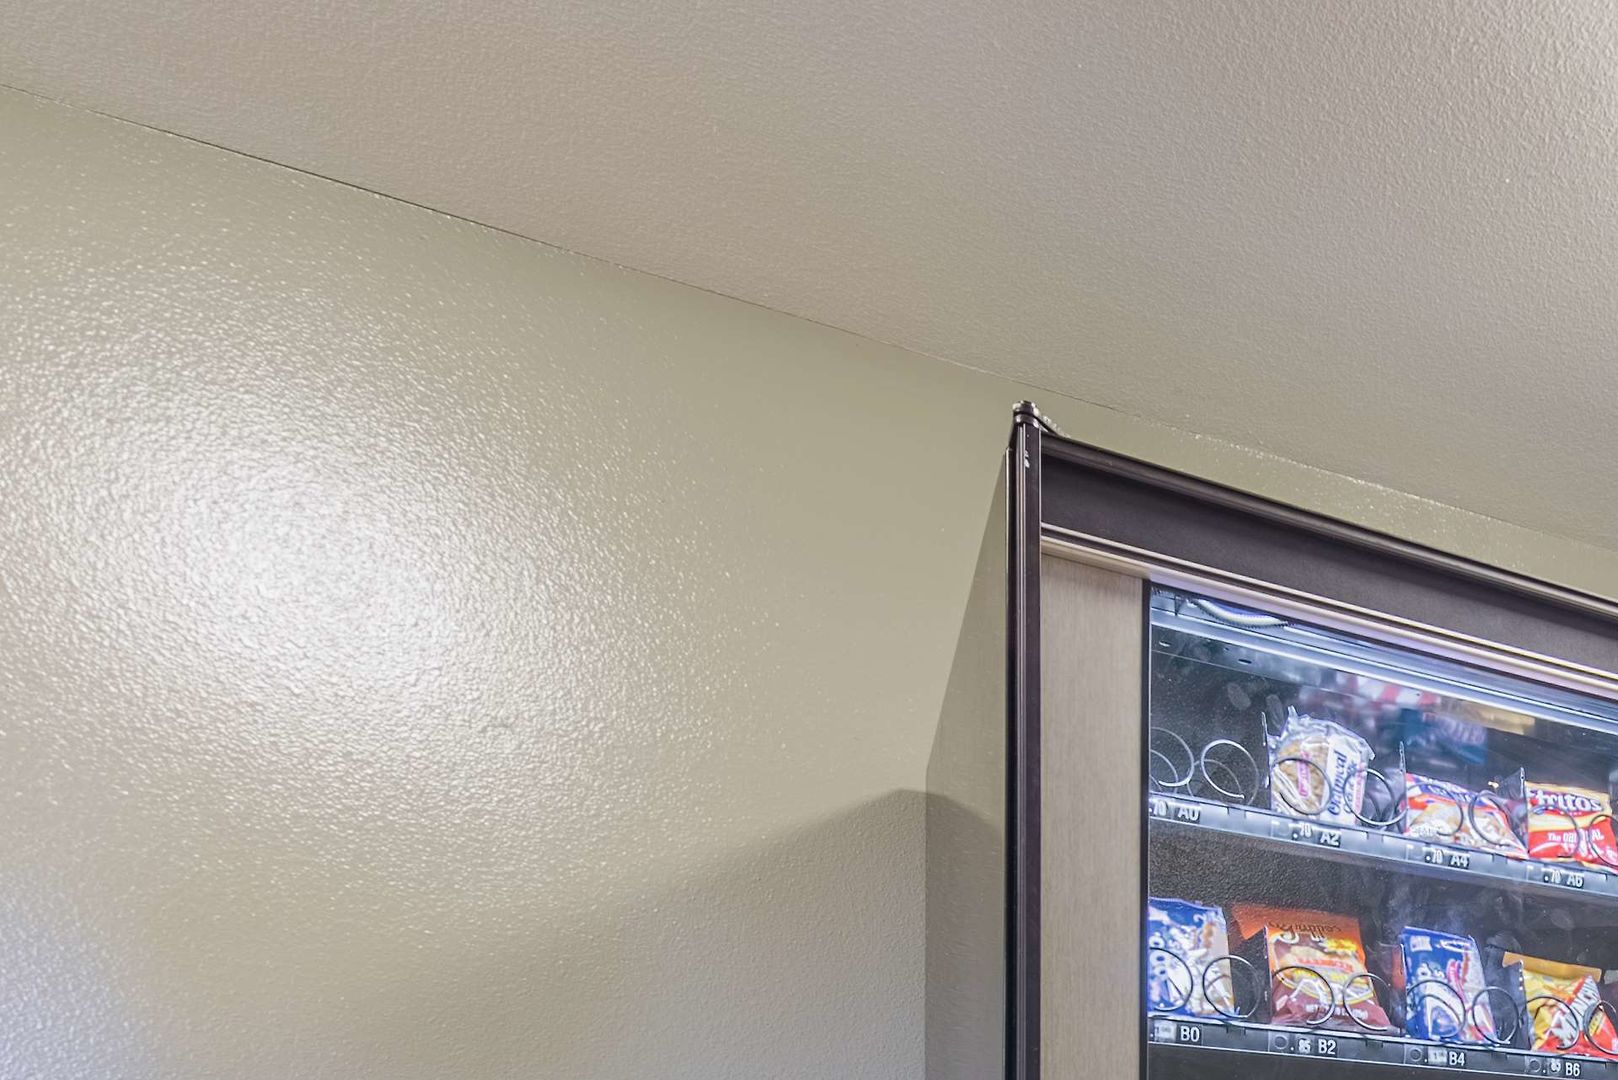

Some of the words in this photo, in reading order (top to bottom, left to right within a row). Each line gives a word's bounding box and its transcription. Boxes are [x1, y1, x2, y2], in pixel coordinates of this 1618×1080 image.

[1178, 806, 1199, 821] A0
[1320, 829, 1340, 845] A2
[1450, 853, 1468, 868] A4
[1567, 874, 1583, 887] A6
[1181, 1026, 1200, 1042] B0
[1319, 1039, 1336, 1055] B2
[1449, 1053, 1465, 1067] B4
[1565, 1063, 1580, 1077] B6
